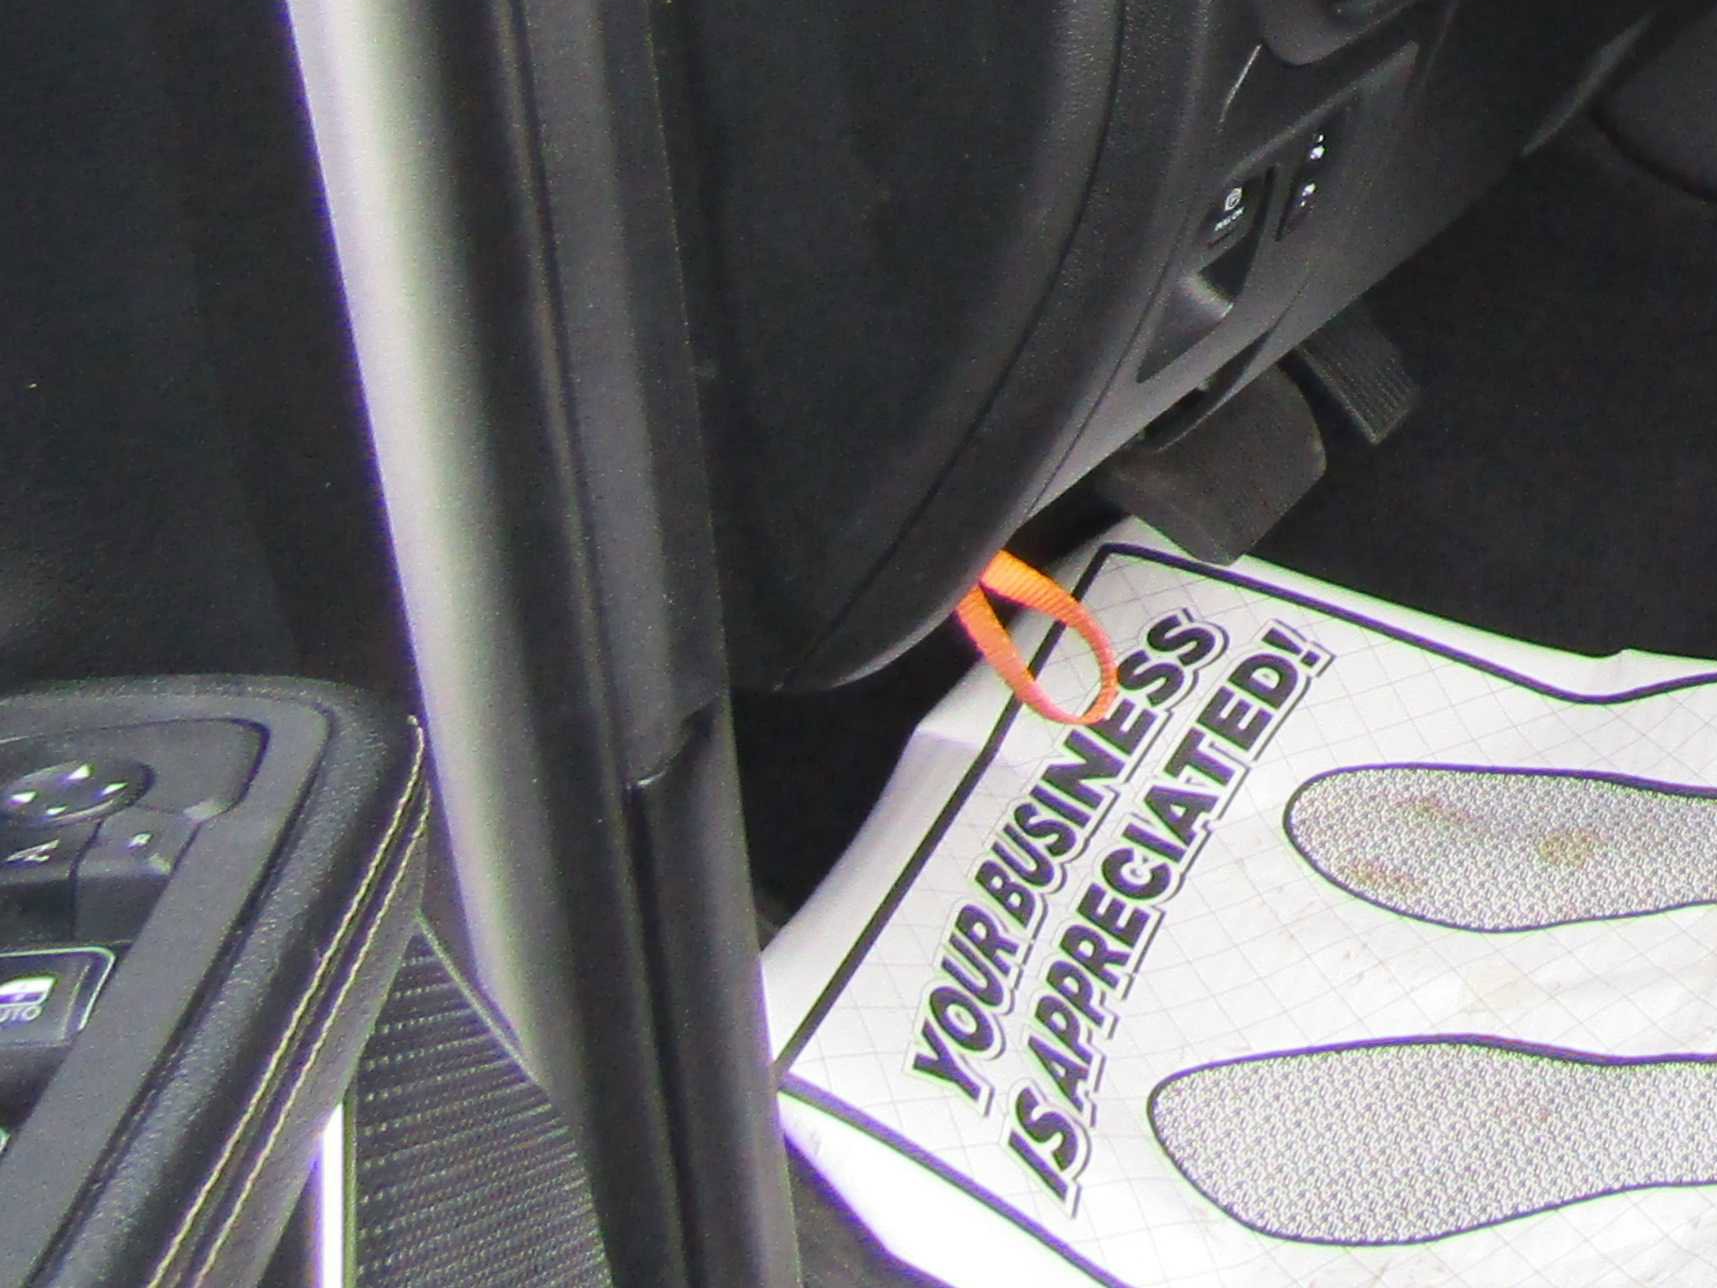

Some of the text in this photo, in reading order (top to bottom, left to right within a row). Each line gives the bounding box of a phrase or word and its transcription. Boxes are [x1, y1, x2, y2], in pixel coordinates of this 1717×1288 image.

[912, 614, 1217, 1102] YOUR BUSINESS
[1007, 626, 1322, 1202] IS APPRECIATED!
